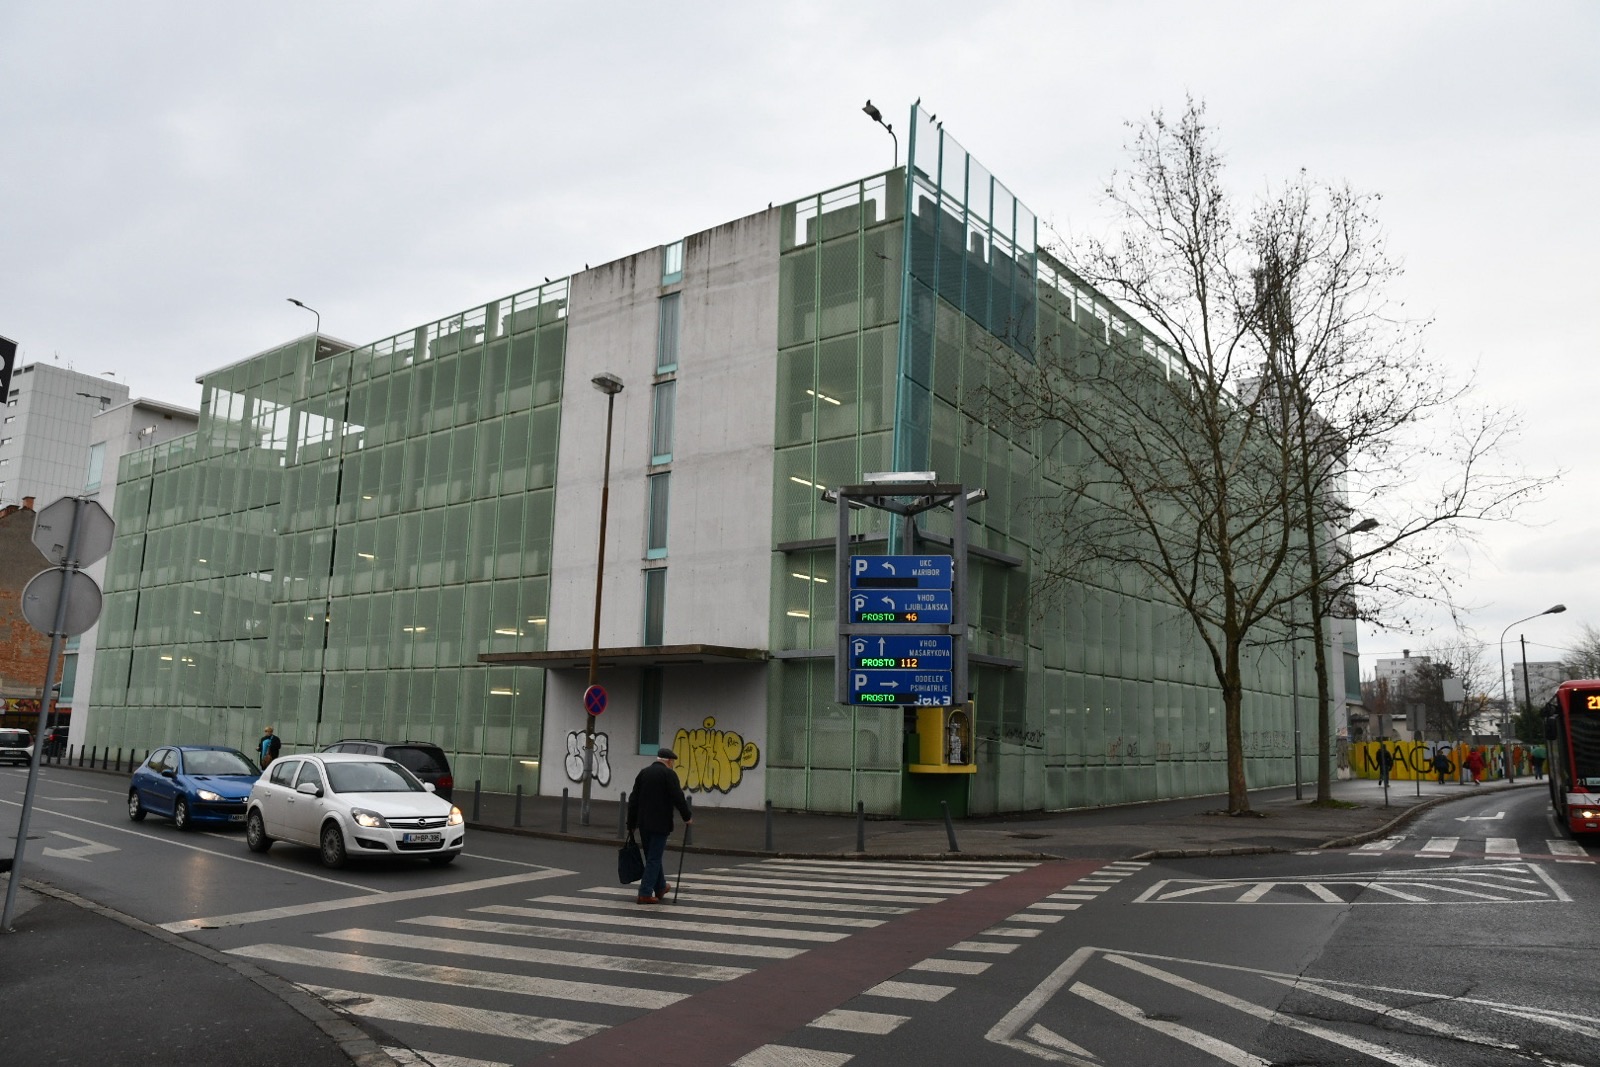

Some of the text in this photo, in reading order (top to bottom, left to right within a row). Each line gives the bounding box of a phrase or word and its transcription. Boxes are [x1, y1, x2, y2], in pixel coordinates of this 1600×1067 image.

[856, 560, 868, 576] P
[917, 594, 935, 602] VHOD
[855, 598, 865, 612] P
[904, 603, 949, 611] LJUBLJANSKA
[861, 613, 918, 621] PROSTO 46
[855, 643, 865, 656] P
[909, 649, 950, 657] MASARYKOVA
[861, 658, 918, 668] PROSTO 112
[855, 674, 868, 691] P
[915, 675, 944, 683] ODDELEK
[910, 684, 948, 692] PSIHIATRIJE
[861, 694, 895, 702] PROSTO
